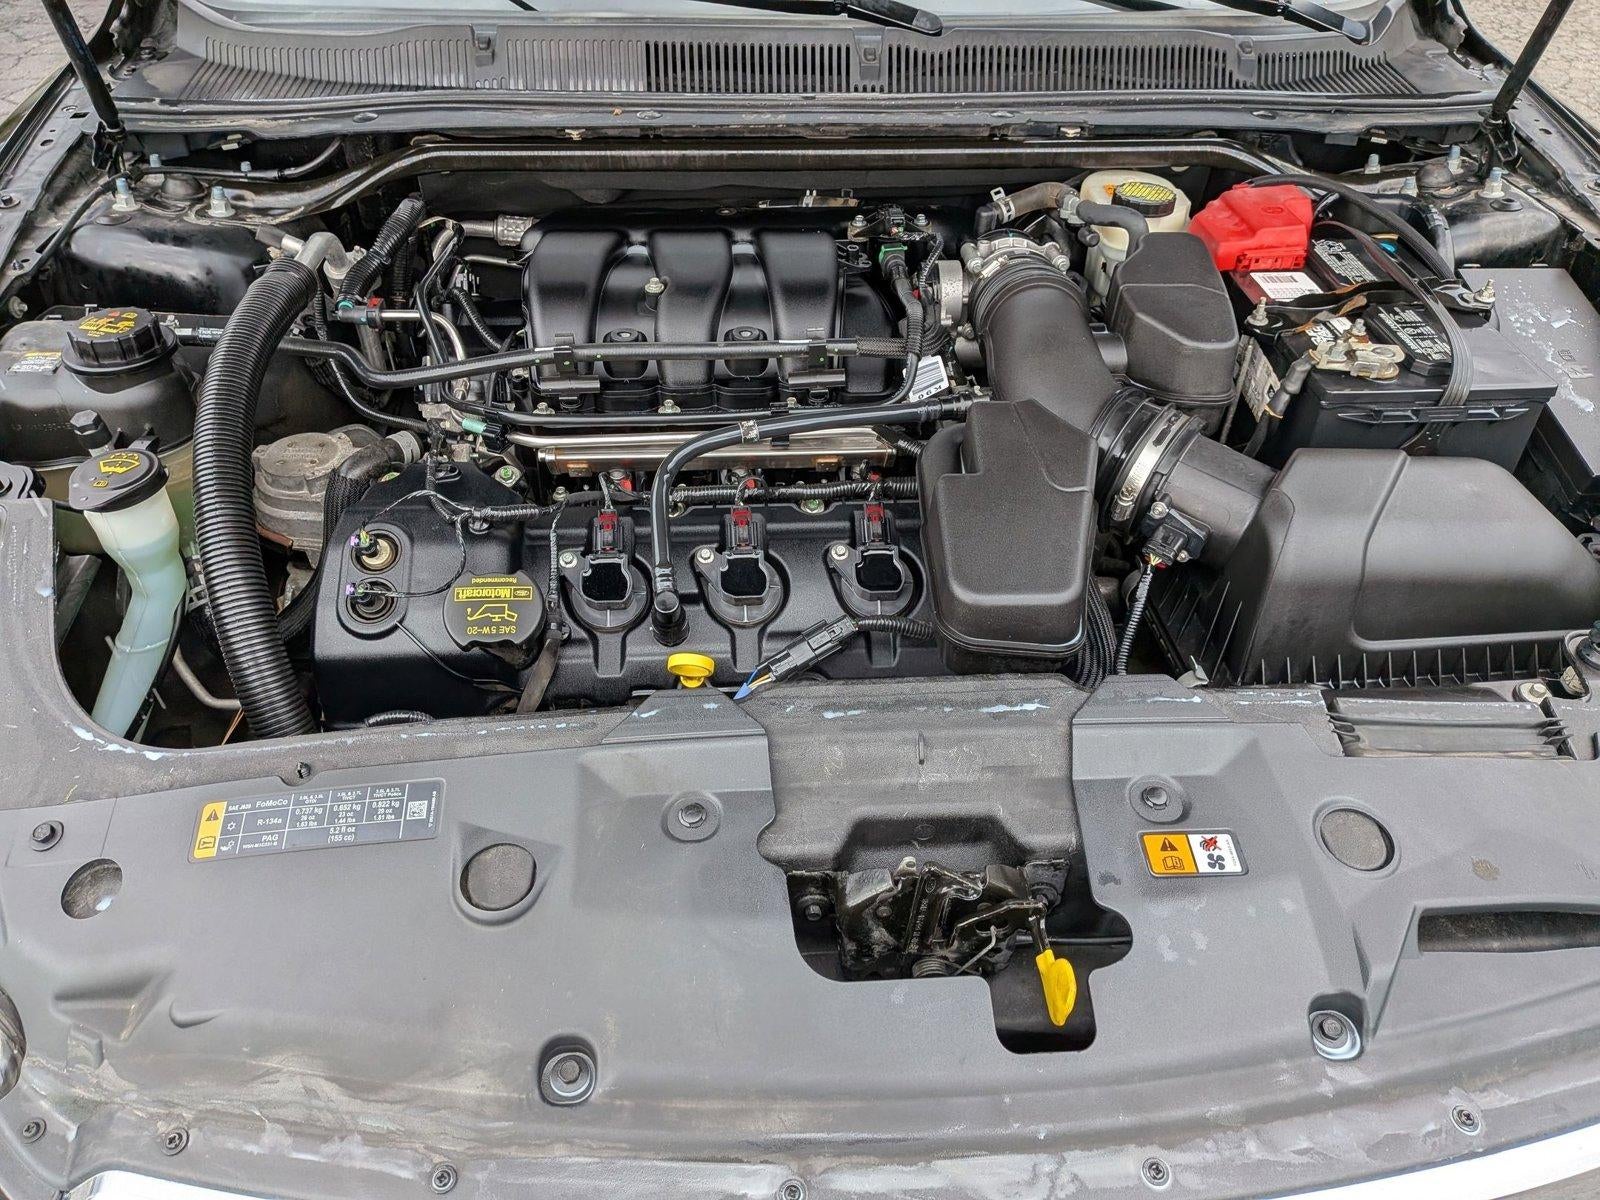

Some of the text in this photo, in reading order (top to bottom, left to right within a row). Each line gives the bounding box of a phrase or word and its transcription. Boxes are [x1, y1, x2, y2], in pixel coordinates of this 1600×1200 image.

[457, 588, 511, 599] Motorcraft
[499, 625, 517, 634] SAE
[256, 798, 288, 808] FoMoCo
[314, 806, 323, 816] kg
[352, 804, 362, 812] kg
[256, 818, 282, 826] R-134a
[262, 834, 279, 842] PAG
[328, 834, 354, 844] (155 cc)
